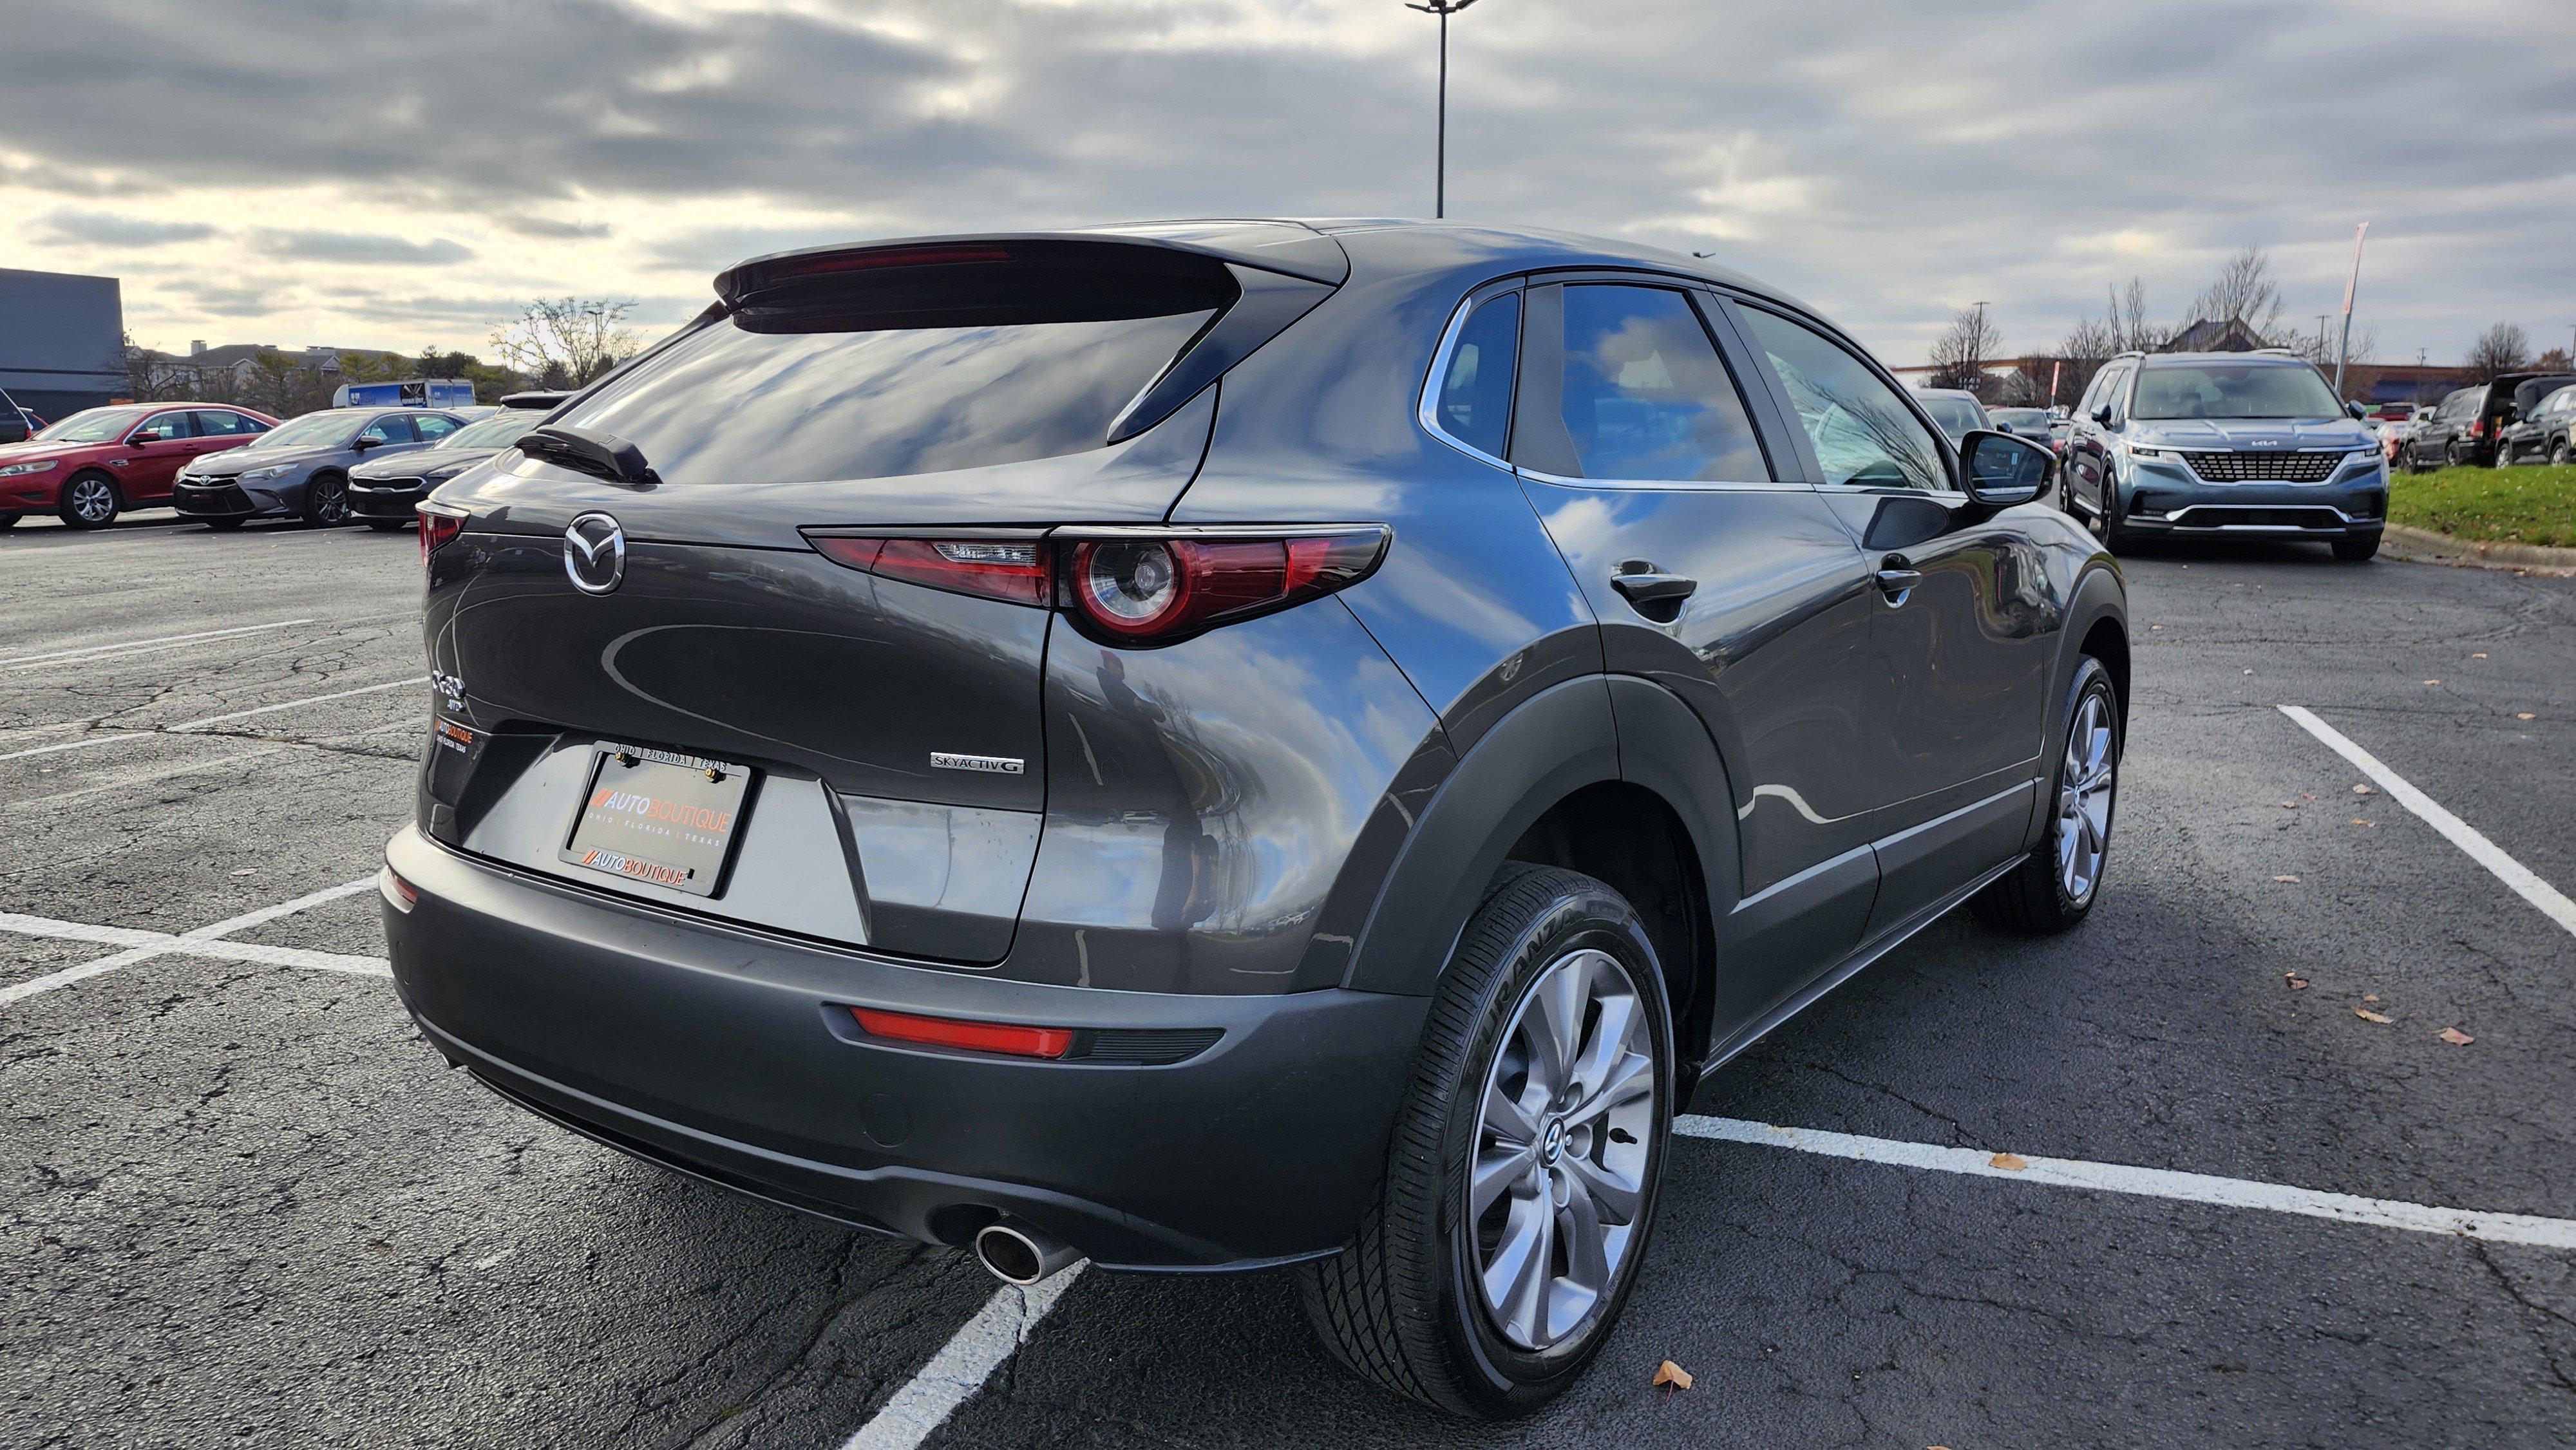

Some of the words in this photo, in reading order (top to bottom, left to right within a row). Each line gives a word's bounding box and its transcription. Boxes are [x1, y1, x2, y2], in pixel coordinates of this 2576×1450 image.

[614, 744, 636, 755] OHIO
[647, 749, 687, 765] FLORIDA
[699, 758, 727, 771] TEXAS
[589, 812, 612, 823] OHIO
[625, 820, 670, 836] FLORIDA
[685, 833, 720, 847] TEXAS
[604, 791, 732, 833] AUTOBOUTIQUE
[592, 851, 688, 886] AUTOBOUTIQUE
